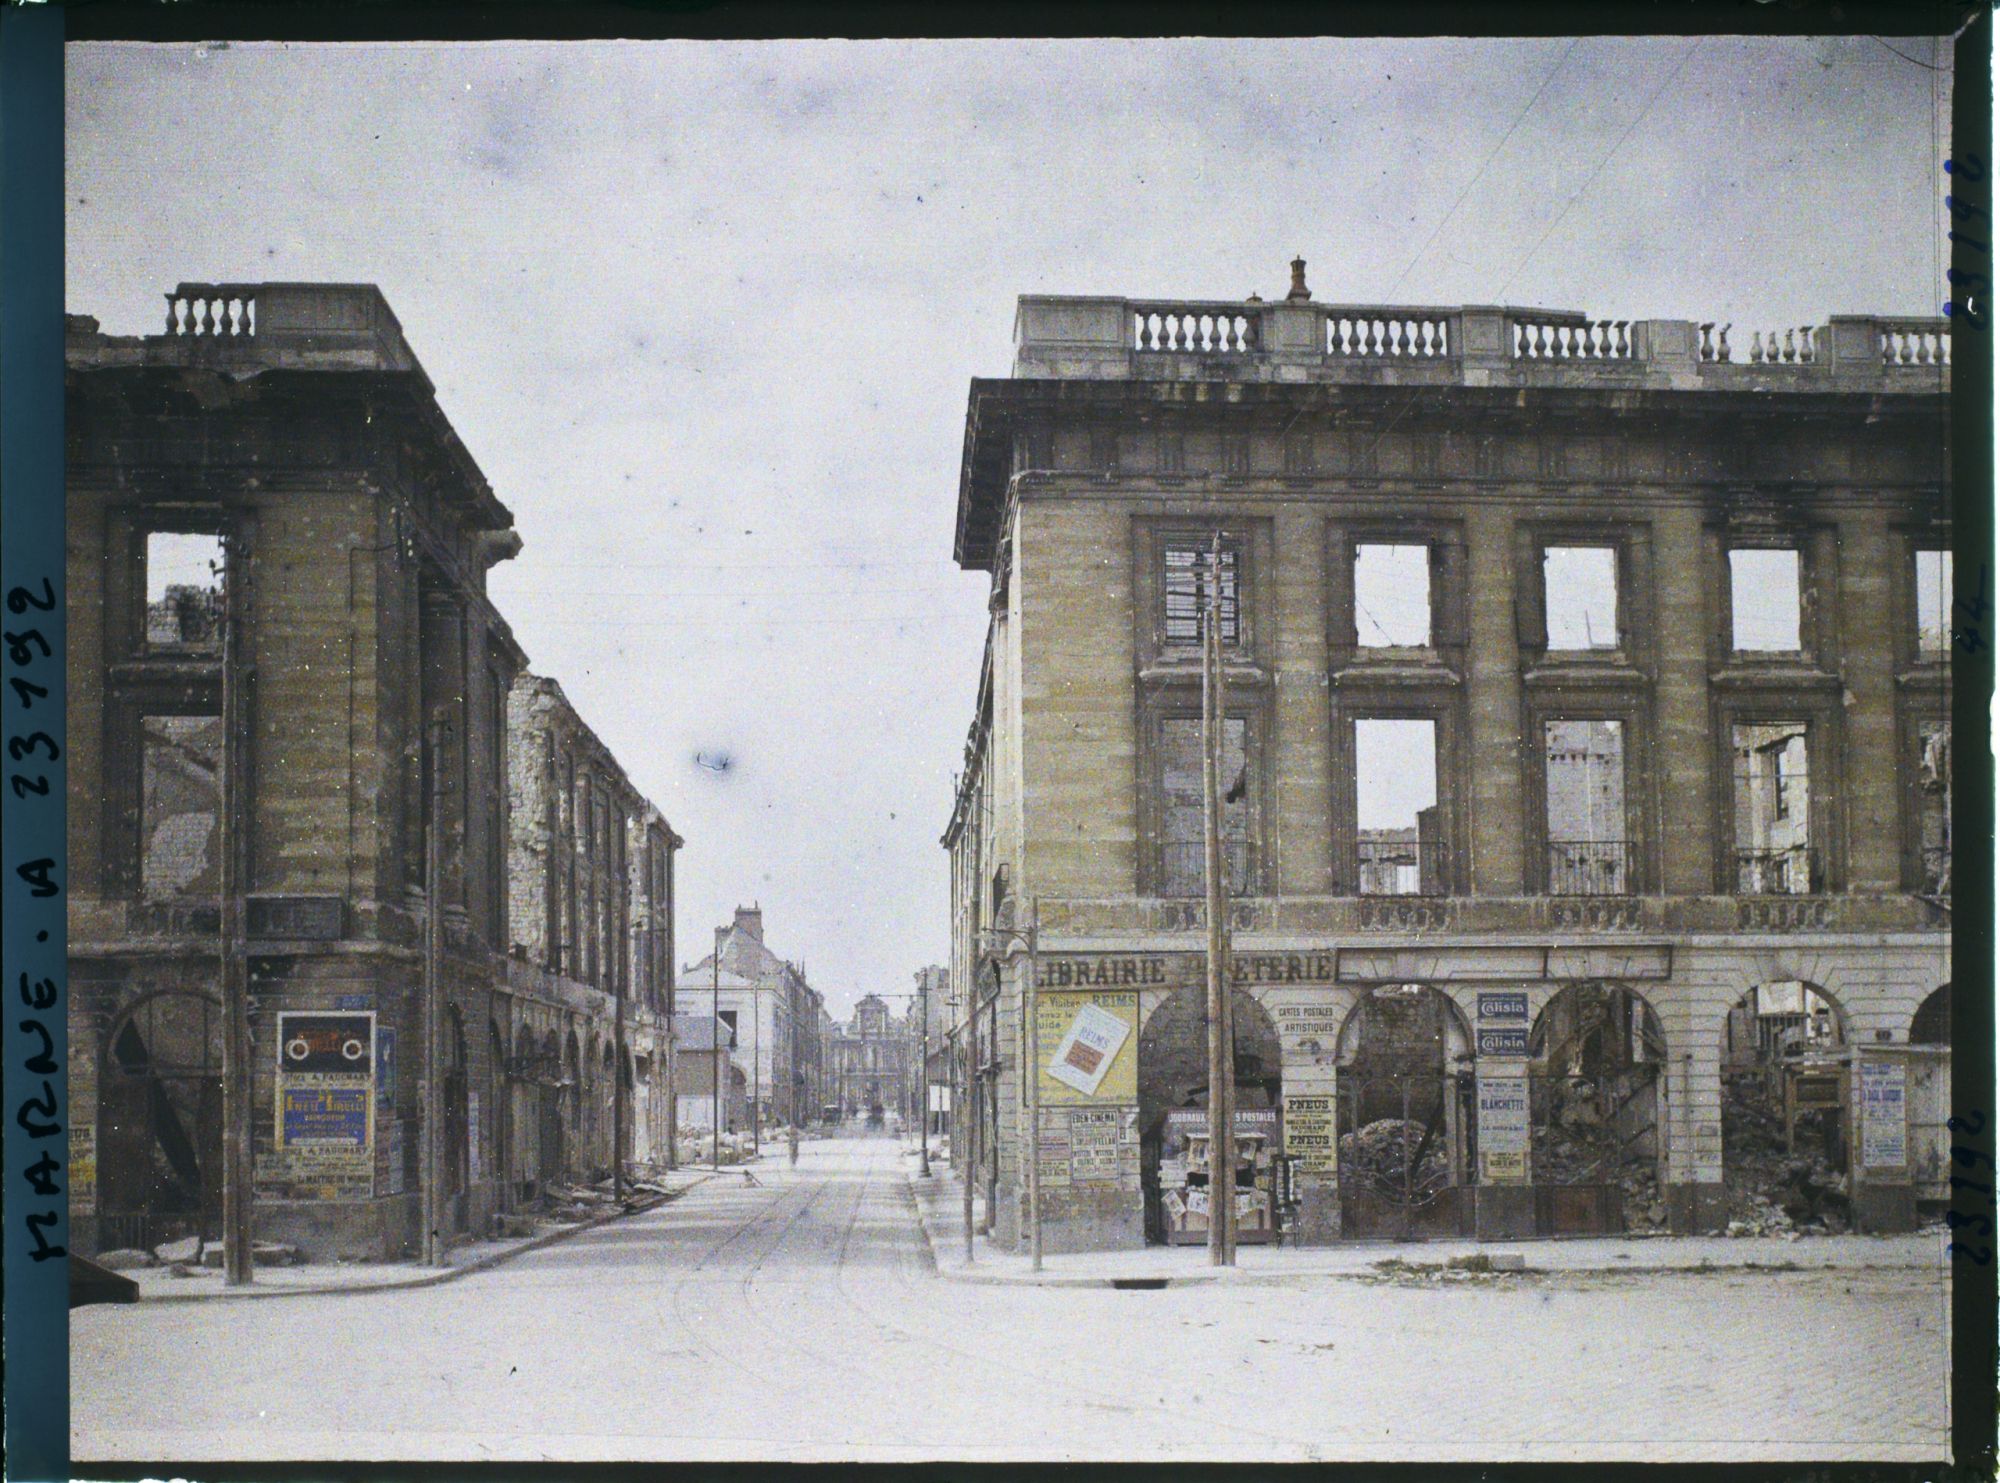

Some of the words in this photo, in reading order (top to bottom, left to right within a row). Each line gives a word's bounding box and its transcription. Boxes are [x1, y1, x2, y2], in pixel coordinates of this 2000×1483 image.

[3, 577, 60, 799] 23192
[16, 857, 59, 899] A
[1232, 956, 1331, 981] ETERIE
[1092, 994, 1136, 1007] REIMS
[1279, 1007, 1301, 1017] CARTES
[1303, 1007, 1333, 1017] POSTALES
[1038, 1020, 1061, 1029] uide
[1285, 1023, 1334, 1033] ARTISTIQUES
[1288, 1100, 1329, 1110] PNEUS
[1168, 1112, 1206, 1123] JOURNAUX
[1242, 1112, 1276, 1122] POSTALES
[1289, 1135, 1330, 1145] PNEUS
